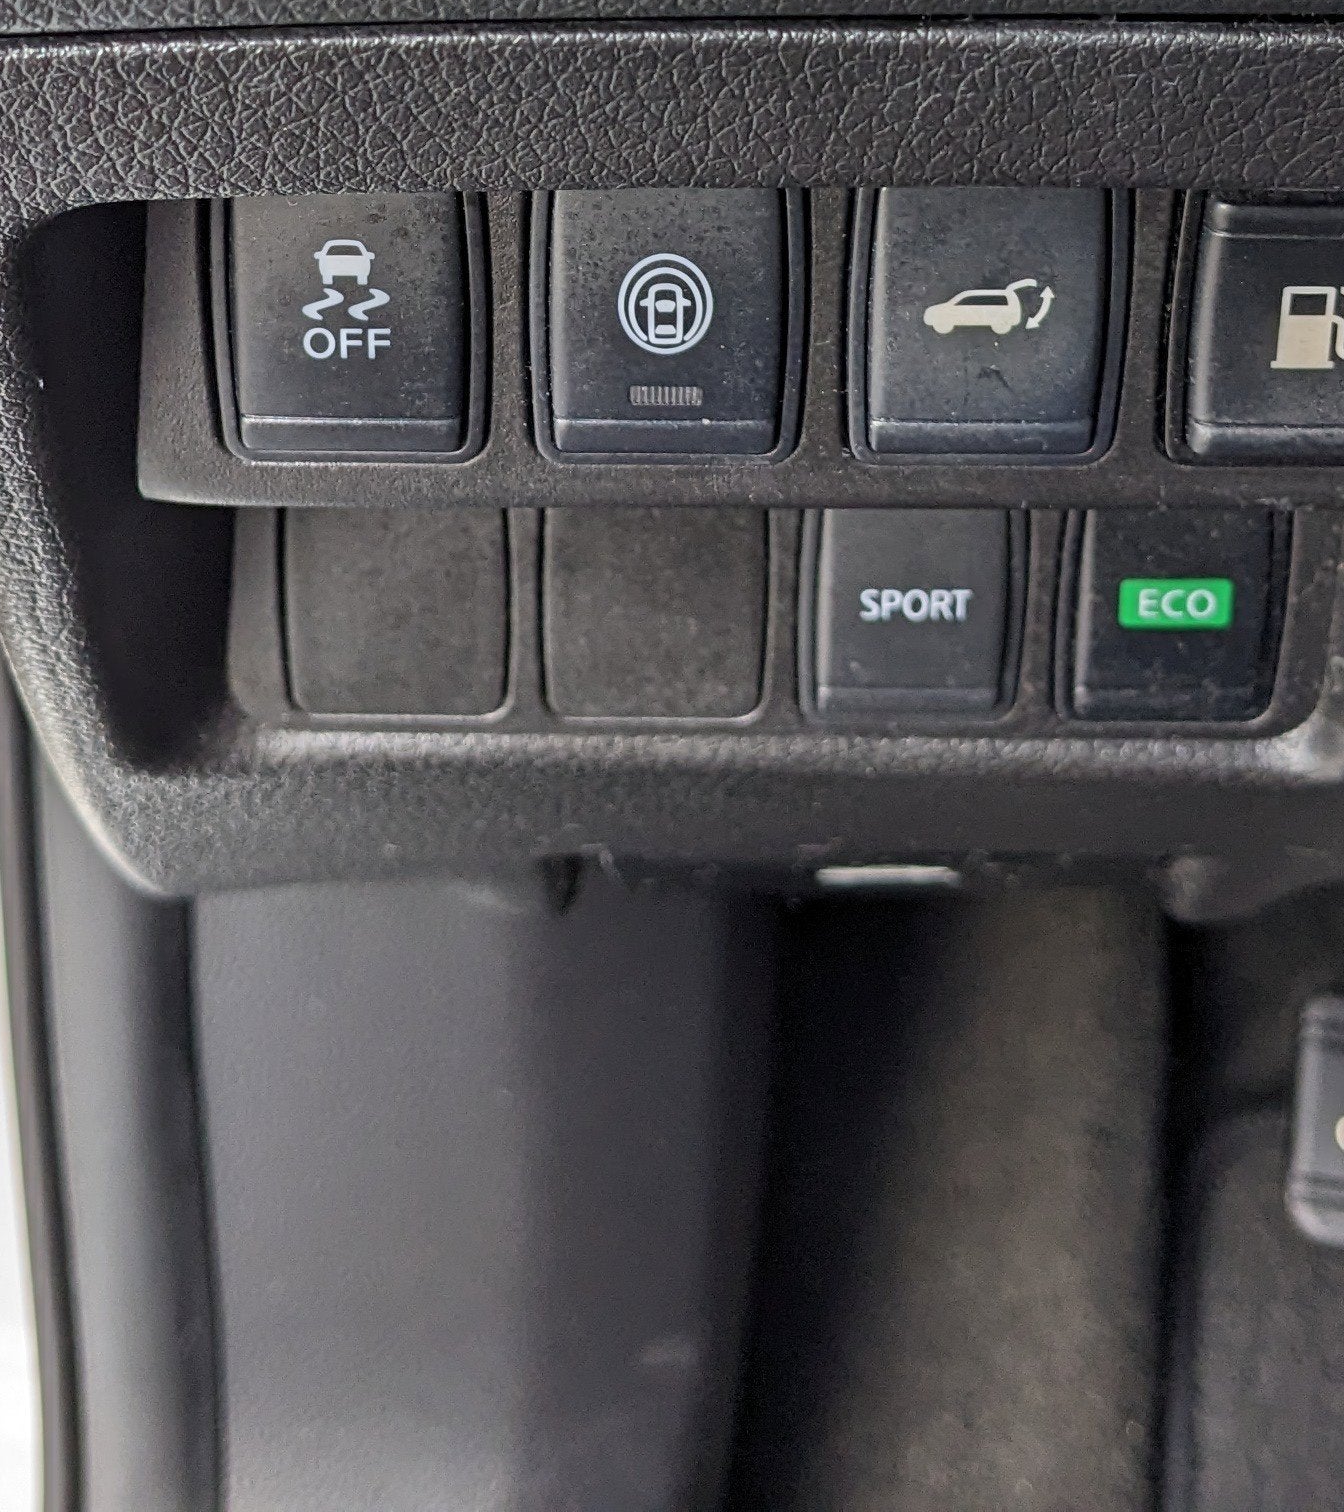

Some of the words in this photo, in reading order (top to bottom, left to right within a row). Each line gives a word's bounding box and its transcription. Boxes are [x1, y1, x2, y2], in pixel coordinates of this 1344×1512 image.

[302, 327, 392, 360] OFF
[859, 587, 971, 622] SPORT
[1138, 588, 1217, 619] ECO
